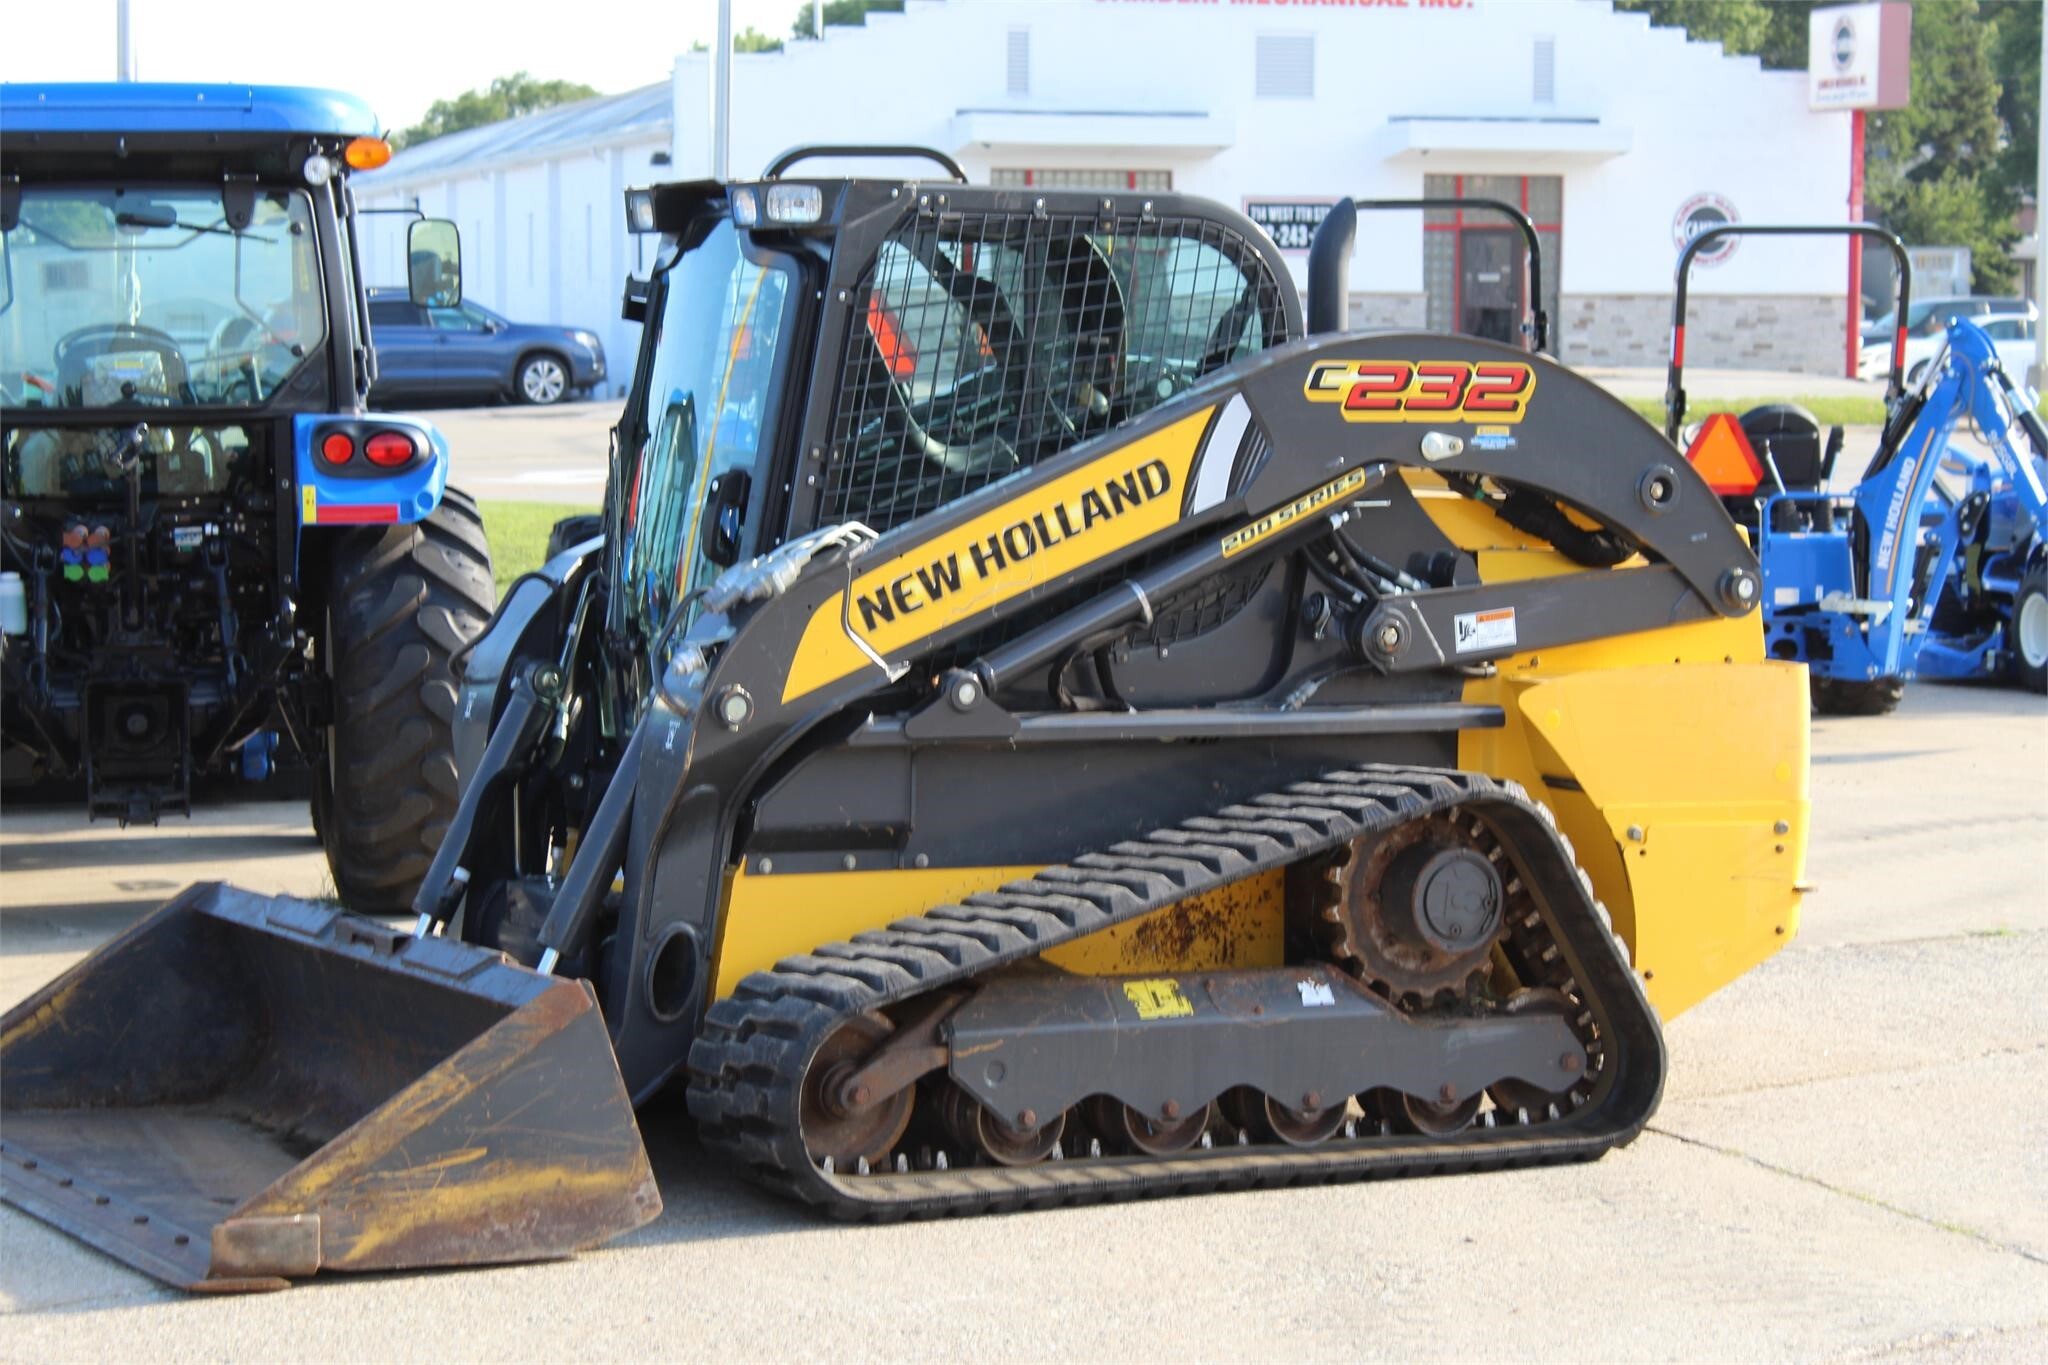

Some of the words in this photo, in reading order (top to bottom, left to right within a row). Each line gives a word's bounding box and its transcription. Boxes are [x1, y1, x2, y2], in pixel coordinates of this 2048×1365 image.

[1306, 362, 1536, 415] C232
[1224, 518, 1273, 551] 200
[1279, 472, 1363, 520] SERIES
[1885, 456, 1916, 532] HOLLAND
[856, 552, 962, 632] NEW
[968, 458, 1172, 580] HOLLAND
[1877, 529, 1895, 569] NEW
